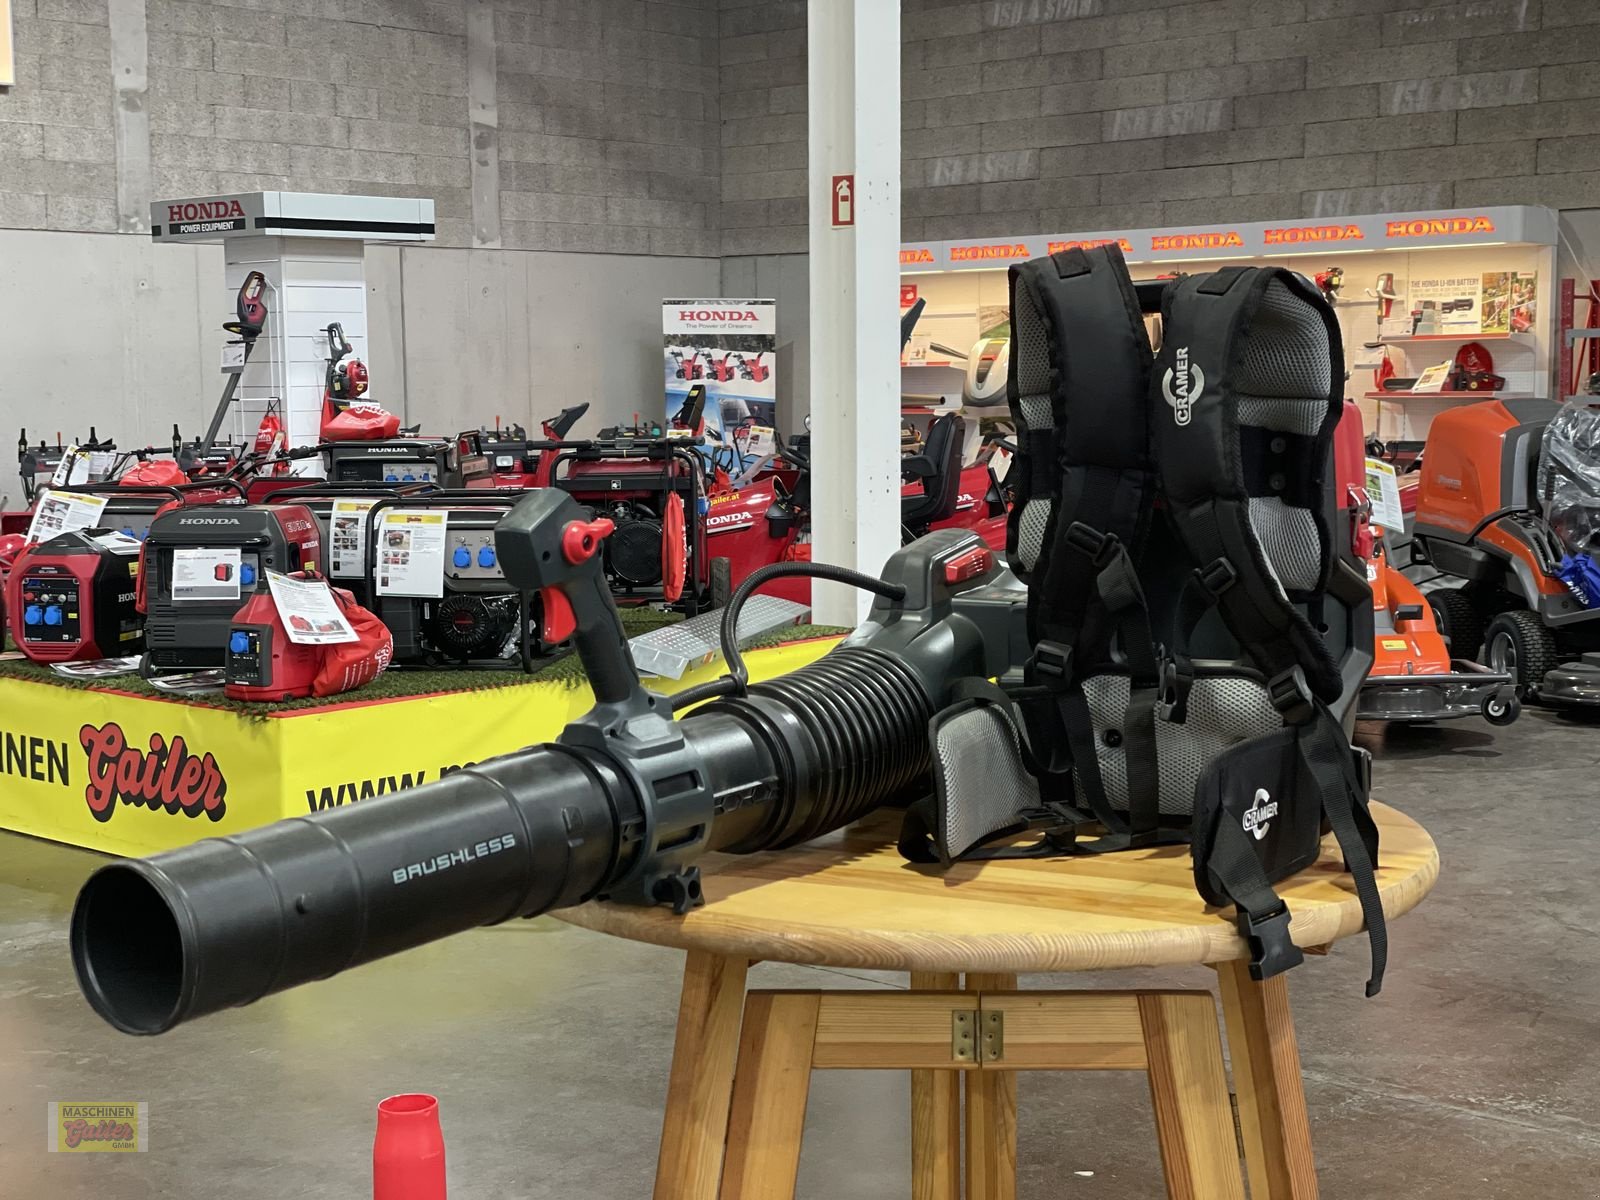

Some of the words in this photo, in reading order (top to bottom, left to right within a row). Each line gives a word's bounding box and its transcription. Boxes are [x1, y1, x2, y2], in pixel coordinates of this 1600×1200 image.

[168, 200, 245, 222] HONDA
[180, 223, 200, 233] POWER
[201, 221, 234, 232] EQUIPMENT
[1264, 224, 1364, 245] HONDA
[1385, 216, 1495, 238] HONDA
[1151, 231, 1244, 251] HONDA
[950, 244, 1030, 261] HONDA
[1422, 280, 1439, 288] HONDA
[1457, 278, 1479, 286] BATTERY
[679, 311, 759, 321] HONDA
[1175, 346, 1190, 424] CRAMER
[179, 518, 240, 526] HONDA
[79, 722, 227, 823] Gailer
[1243, 801, 1278, 830] CRAMER
[392, 833, 517, 885] BRUSHLESS
